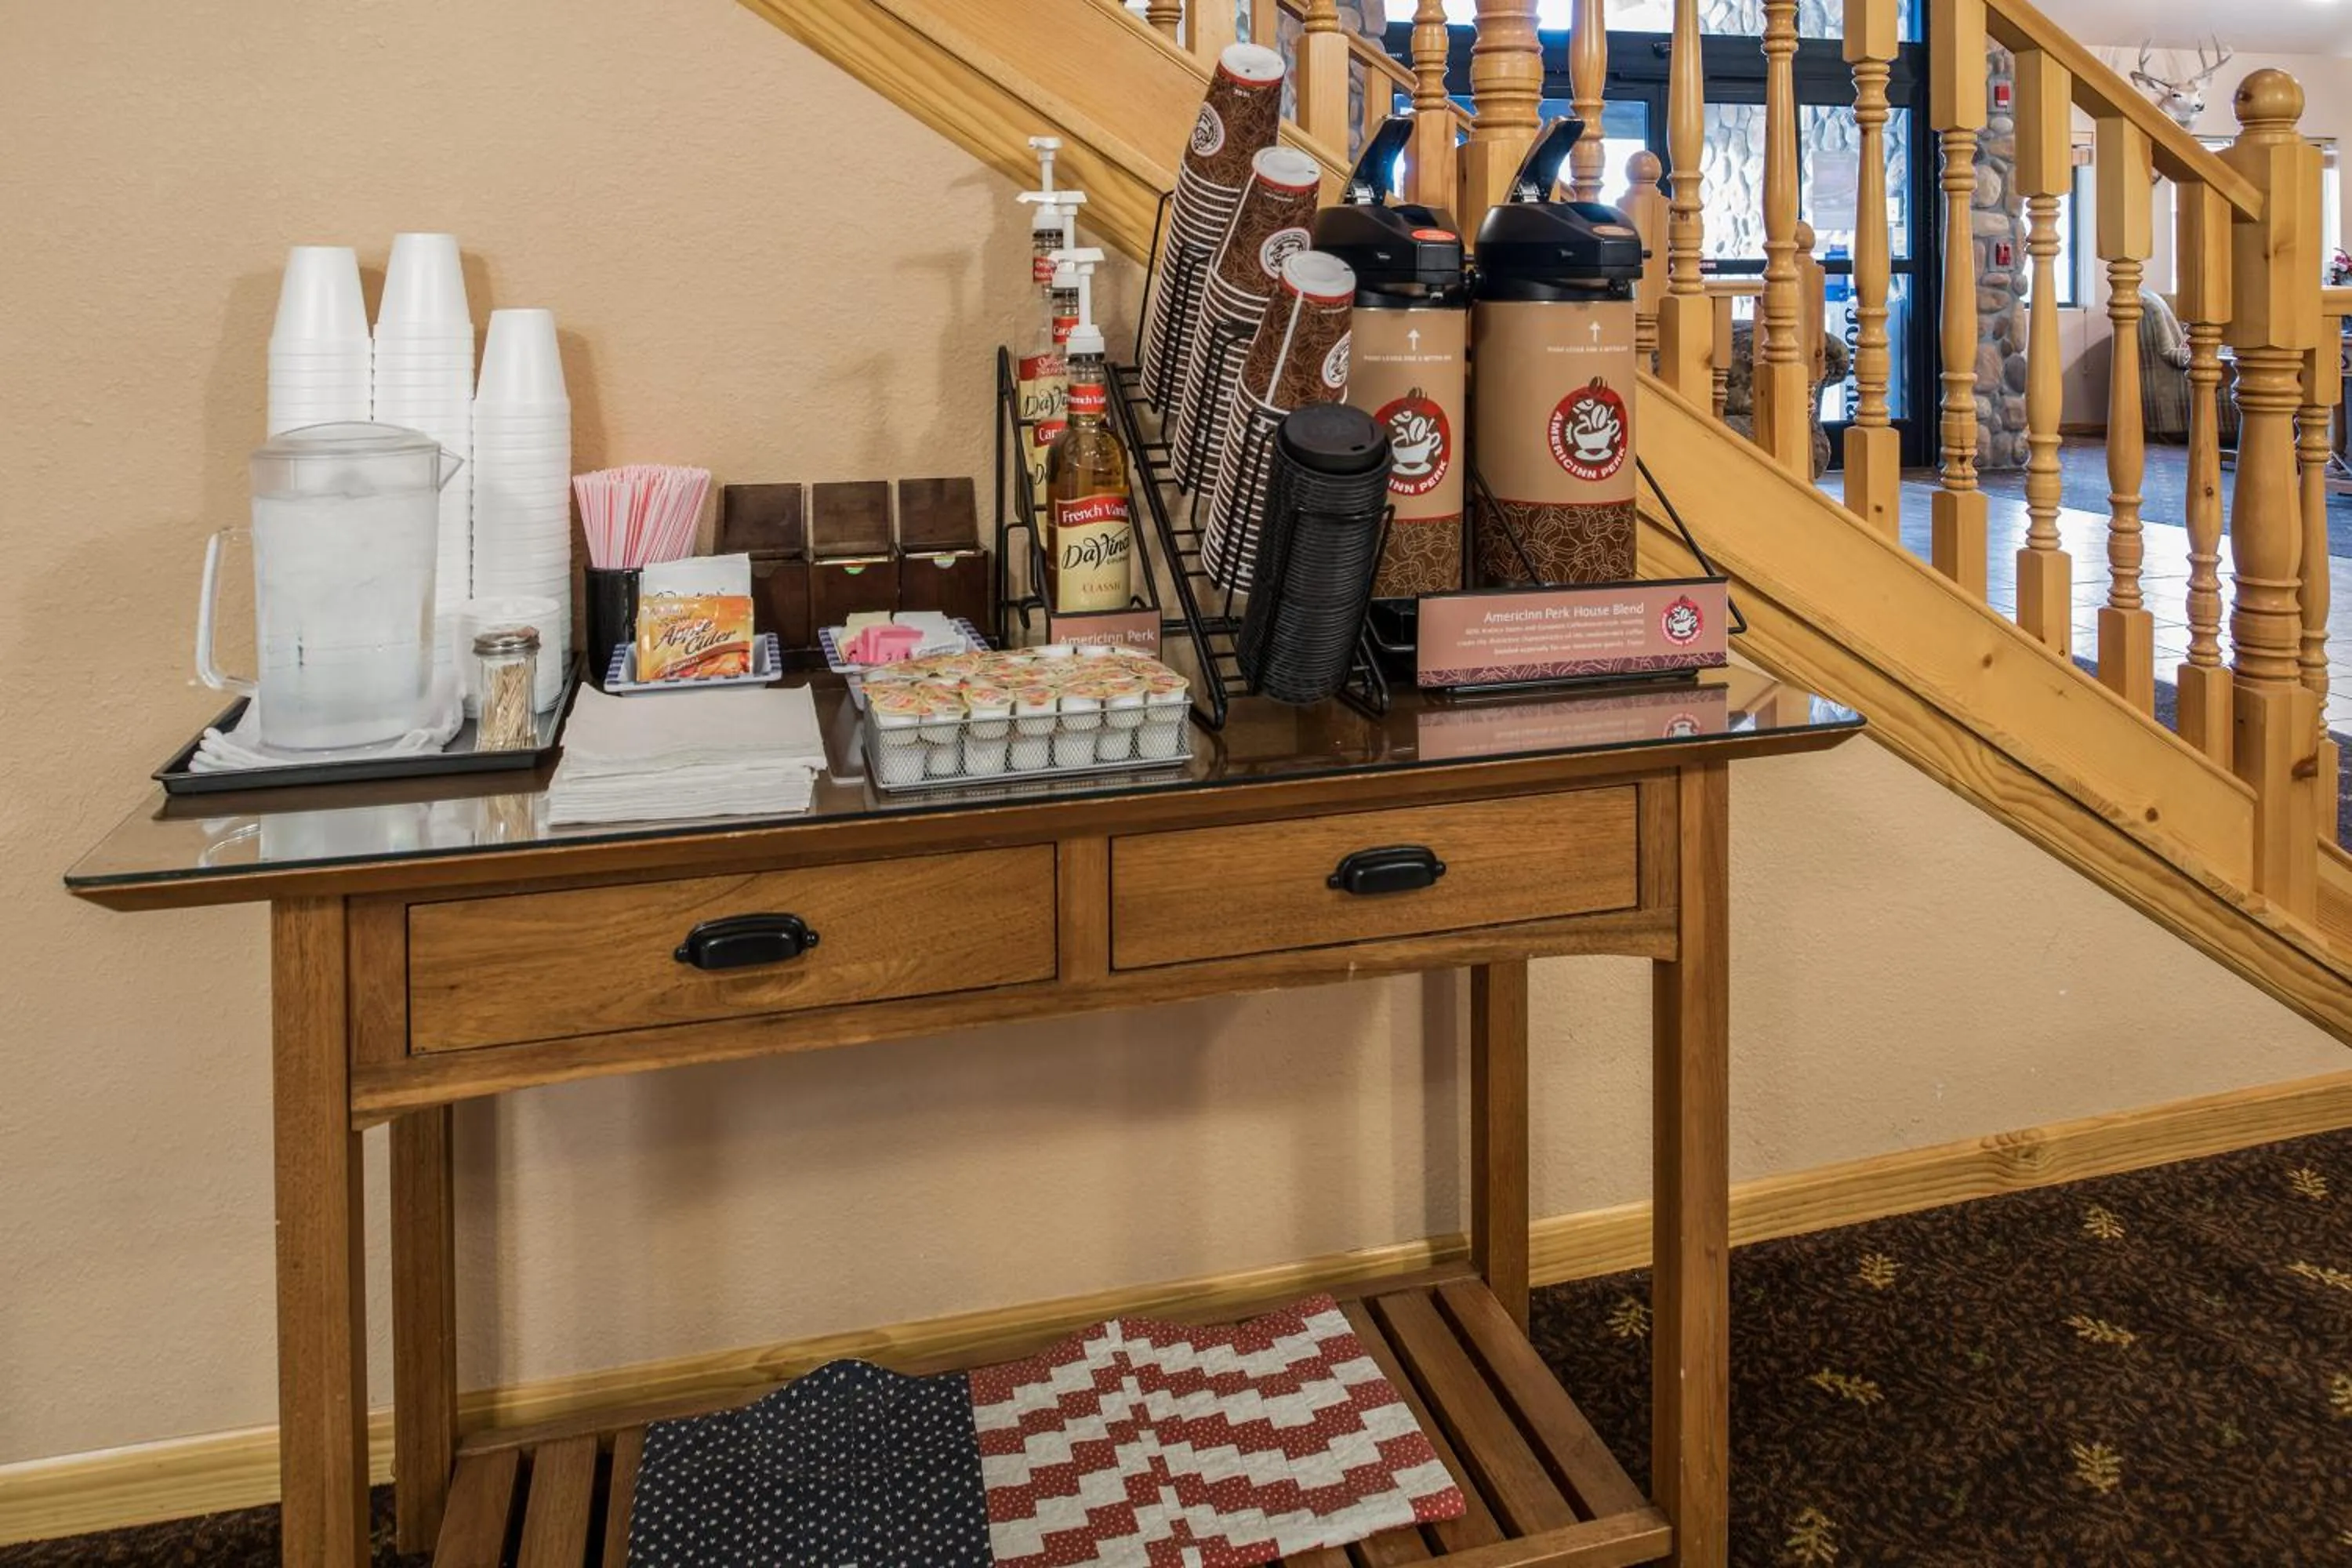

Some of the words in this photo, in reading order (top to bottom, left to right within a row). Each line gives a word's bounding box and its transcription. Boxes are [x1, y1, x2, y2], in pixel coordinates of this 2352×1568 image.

[1039, 427, 1059, 441] Car
[1601, 447, 1626, 477] PERK
[1388, 477, 1415, 494] INN
[1420, 459, 1448, 492] PERK
[1062, 503, 1102, 524] French
[1545, 605, 1570, 619] Perk
[1573, 605, 1610, 619] House
[1613, 601, 1644, 616] Blend
[684, 629, 737, 655] Cider
[1127, 628, 1155, 643] Perk
